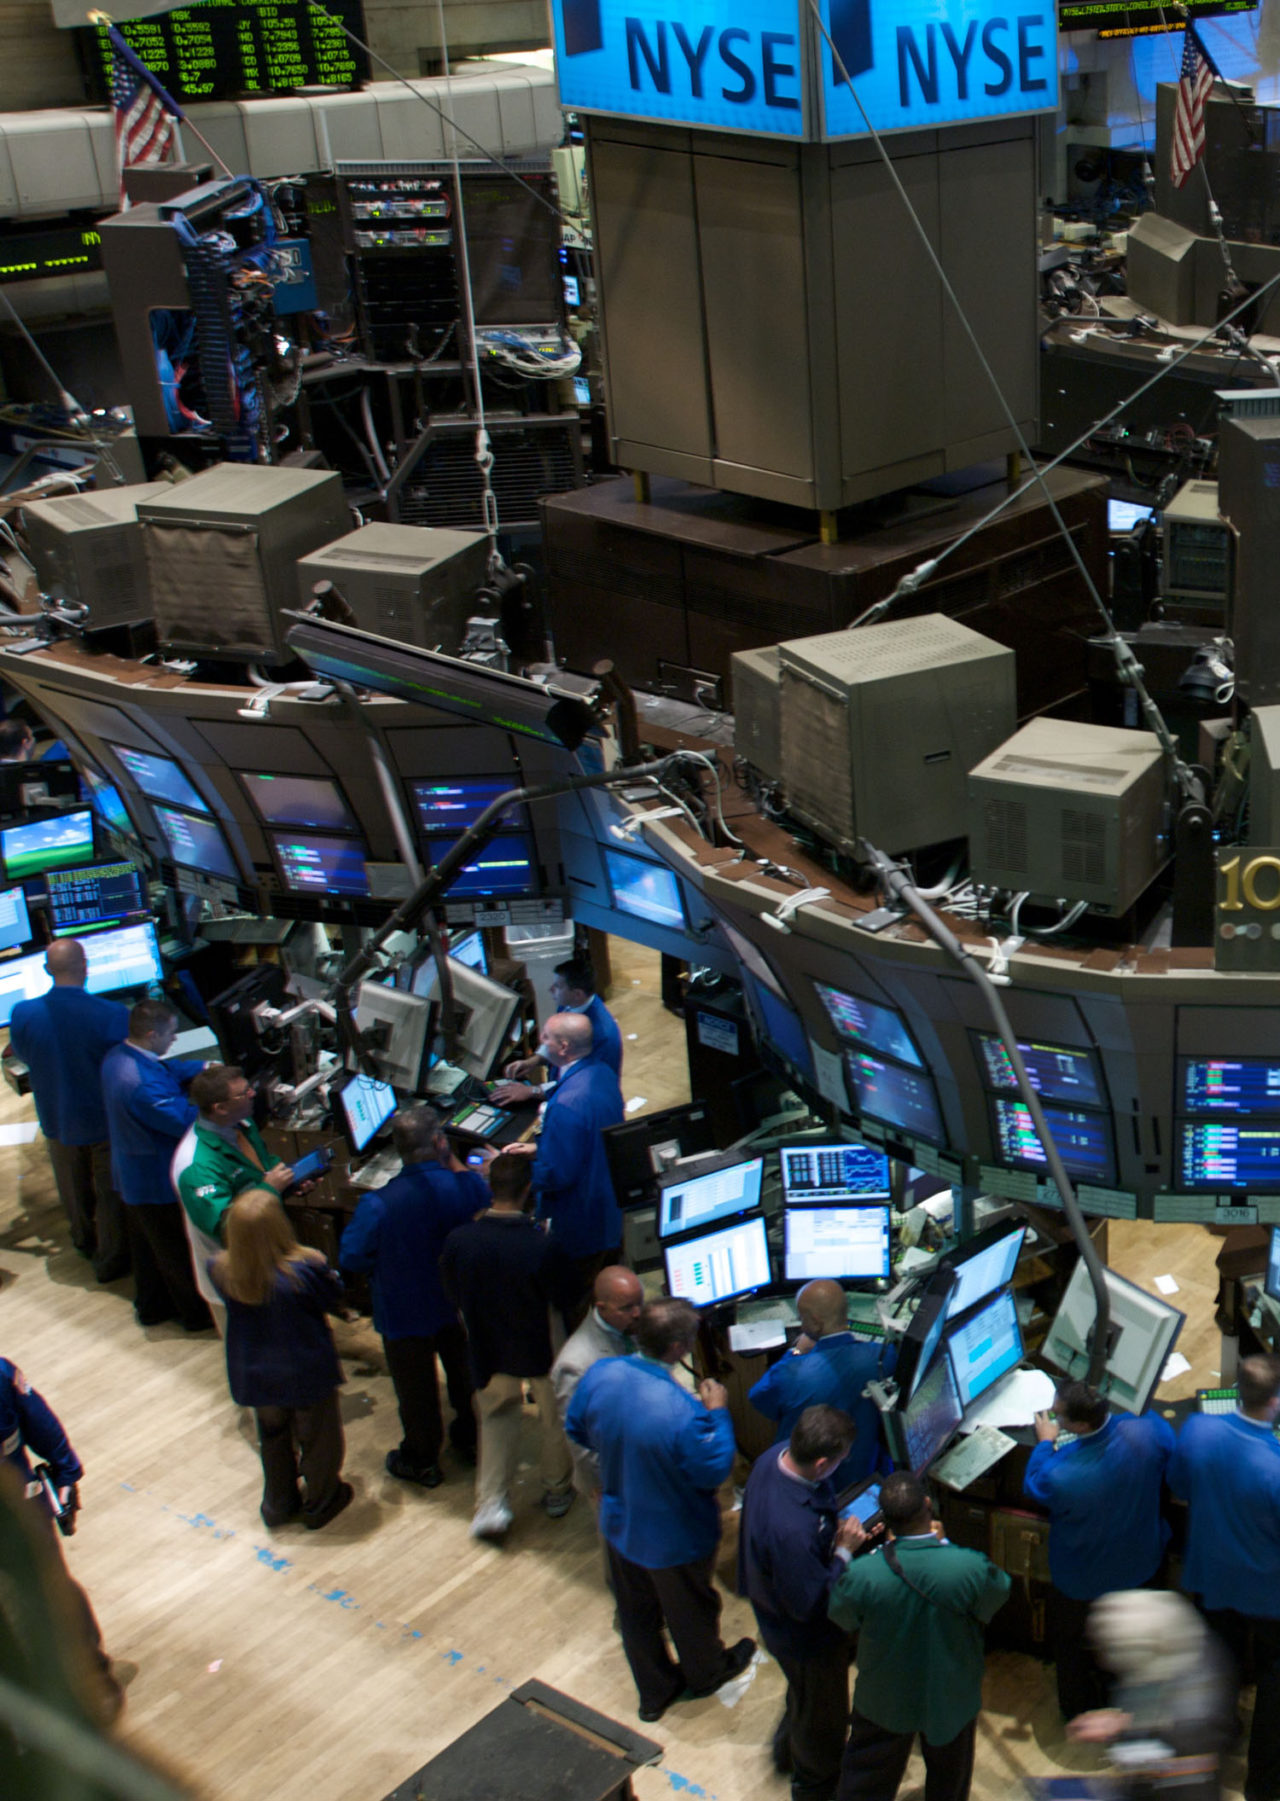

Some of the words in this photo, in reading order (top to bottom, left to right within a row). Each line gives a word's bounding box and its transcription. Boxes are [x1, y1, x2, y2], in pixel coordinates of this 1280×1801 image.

[259, 7, 278, 17] BID
[625, 17, 800, 109] NYSE
[897, 15, 1047, 108] NYSE
